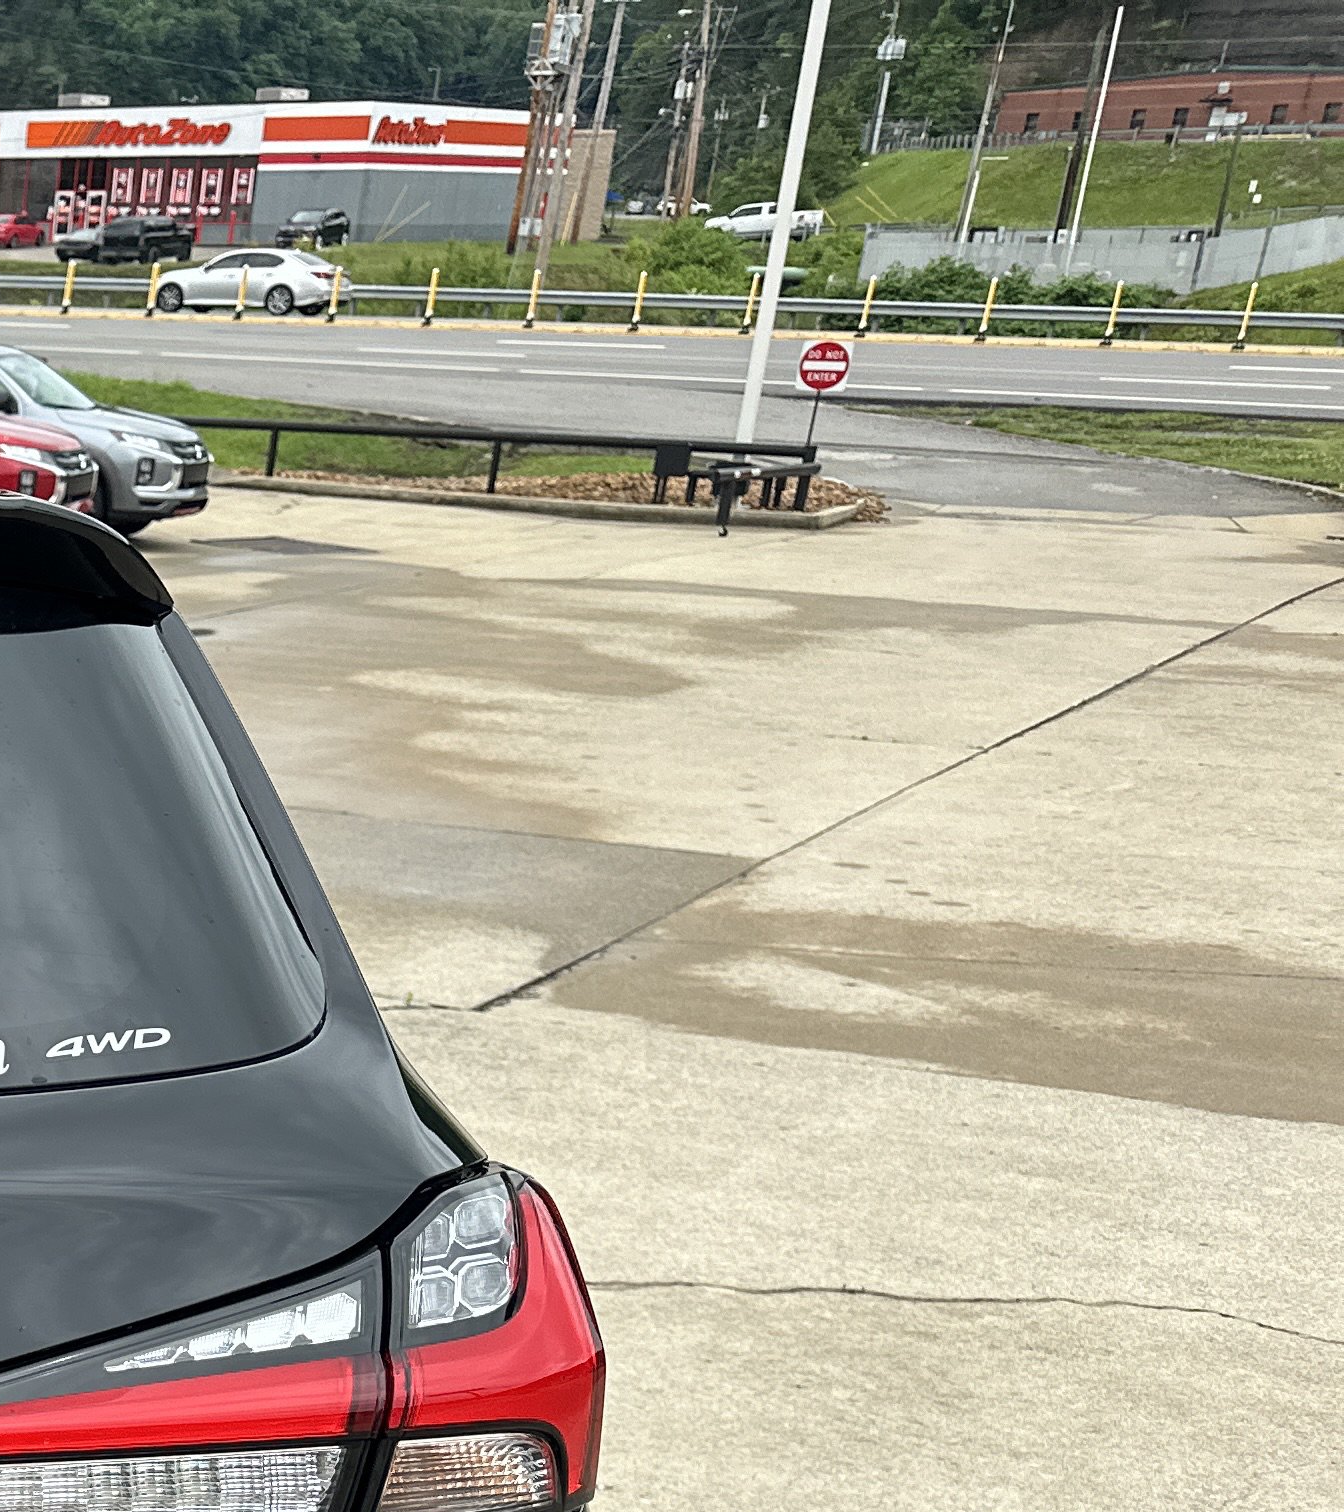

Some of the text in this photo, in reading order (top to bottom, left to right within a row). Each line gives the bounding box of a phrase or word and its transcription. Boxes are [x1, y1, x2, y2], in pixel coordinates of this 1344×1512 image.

[95, 118, 231, 146] AutoZone
[808, 350, 845, 360] DO NOT
[807, 372, 837, 381] ENTER
[45, 1026, 171, 1059] 4WD
